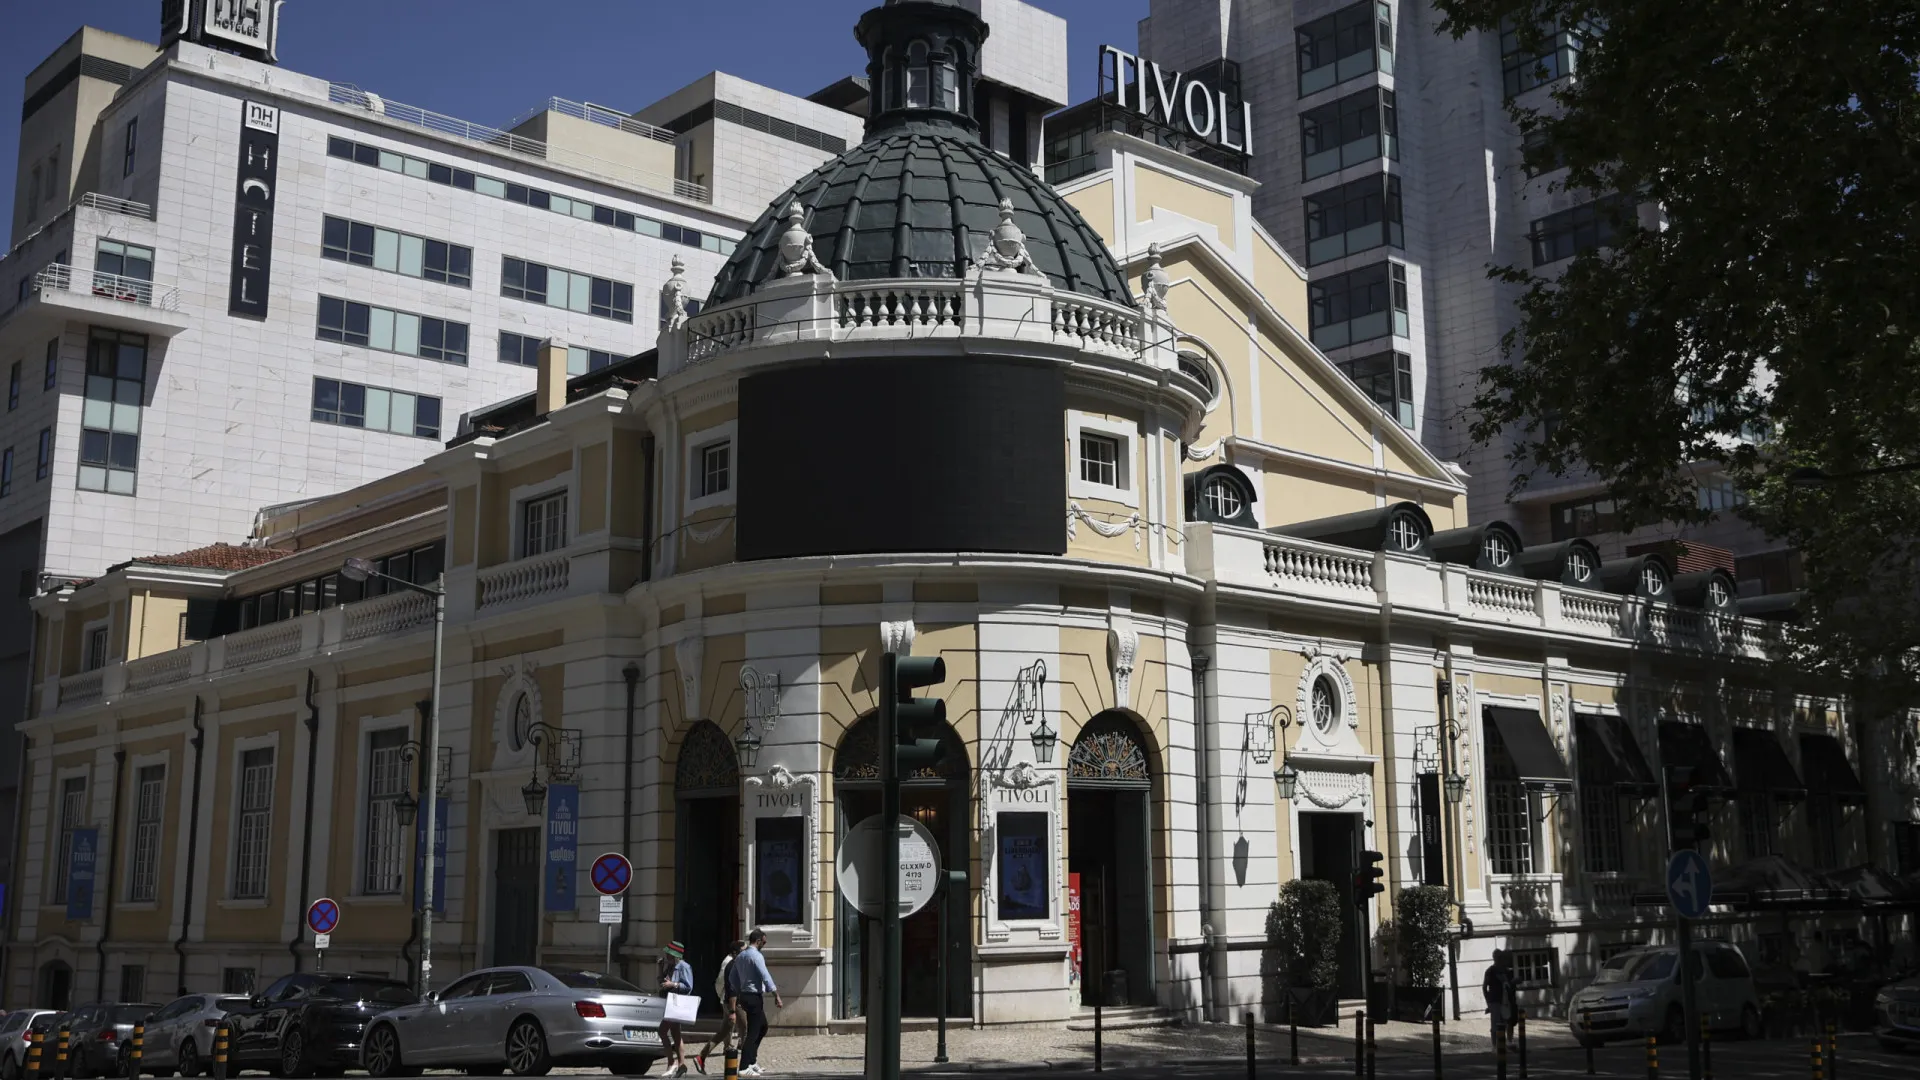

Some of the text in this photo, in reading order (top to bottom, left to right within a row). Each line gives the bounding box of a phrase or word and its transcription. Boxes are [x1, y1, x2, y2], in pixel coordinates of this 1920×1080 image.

[214, 16, 260, 39] HOTELES
[1102, 44, 1254, 156] TIVOLI
[250, 119, 273, 128] HOTELES
[241, 143, 270, 305] HOTEL
[756, 792, 803, 808] TIVOLI
[996, 789, 1049, 803] TIVOLI
[550, 820, 576, 835] TIVOLI
